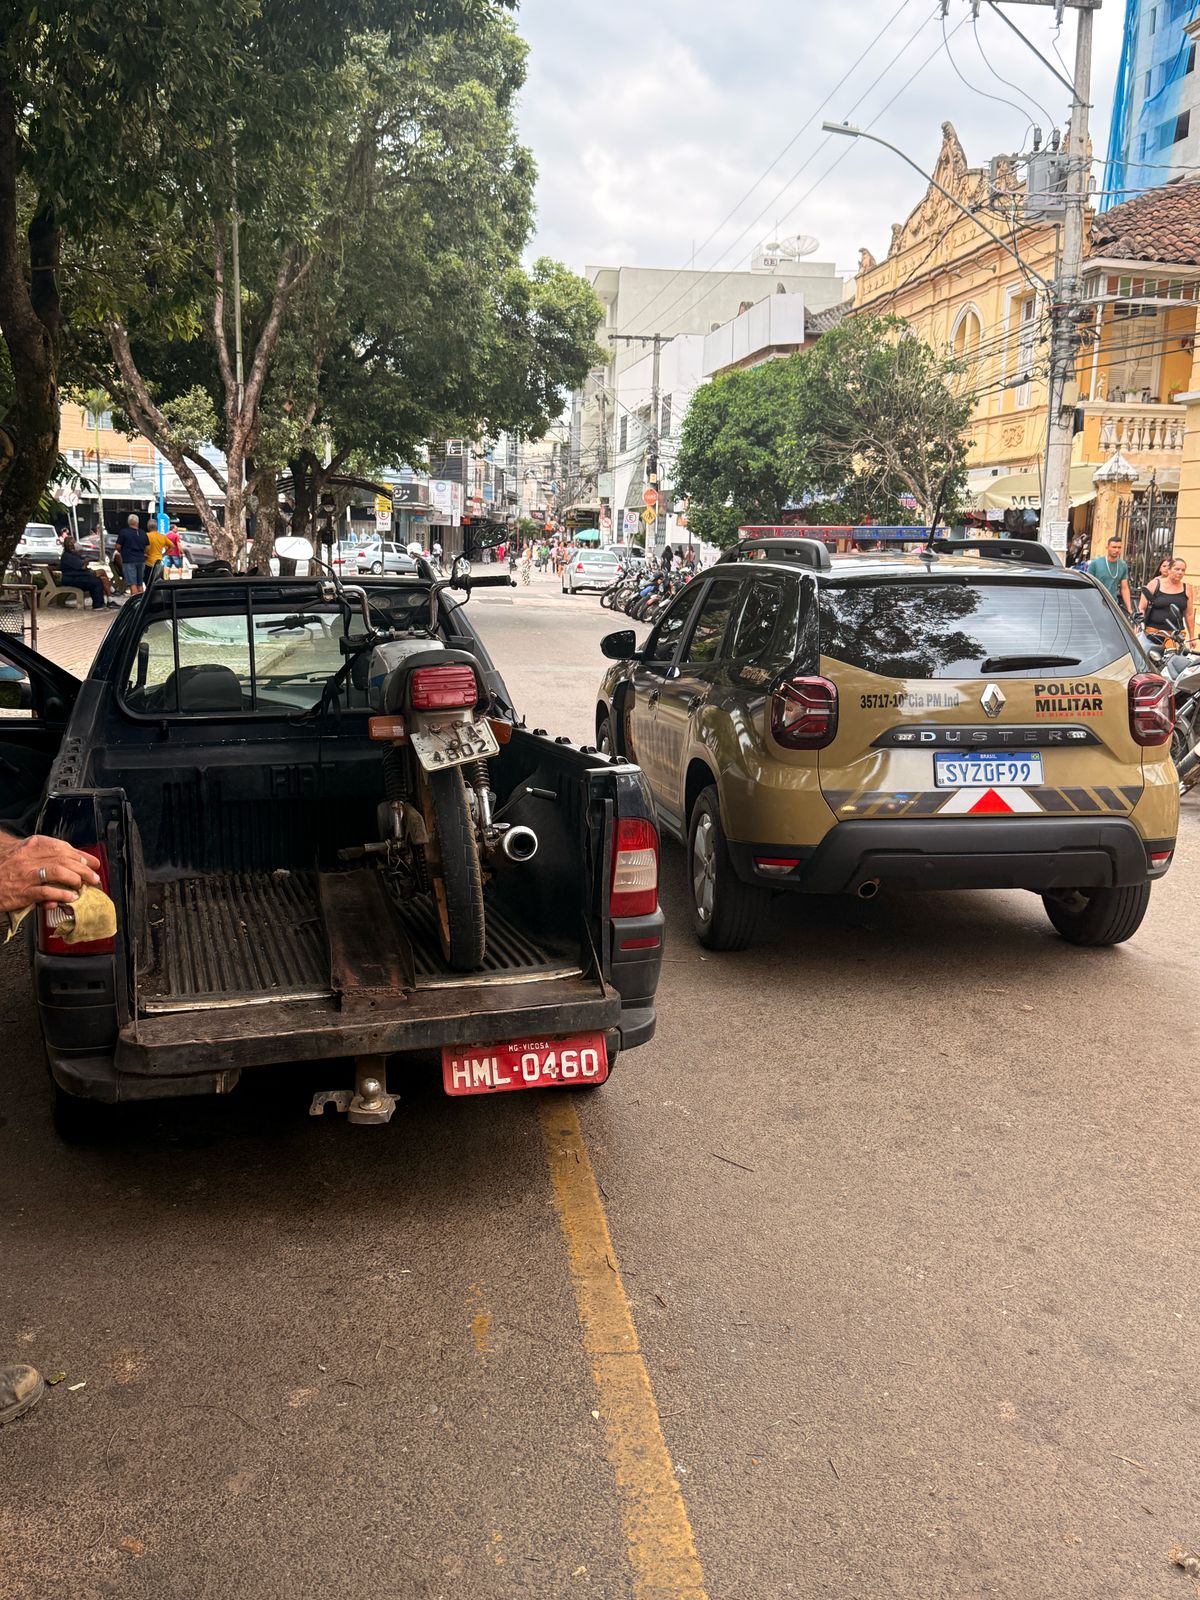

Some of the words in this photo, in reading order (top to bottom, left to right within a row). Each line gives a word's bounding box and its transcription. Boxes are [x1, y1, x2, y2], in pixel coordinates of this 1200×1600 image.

[1034, 683, 1102, 696] POLÍCIA
[908, 692, 925, 707] Cia
[927, 693, 942, 707] PM
[1035, 698, 1103, 712] MILITAR
[920, 731, 1063, 742] DUSTER
